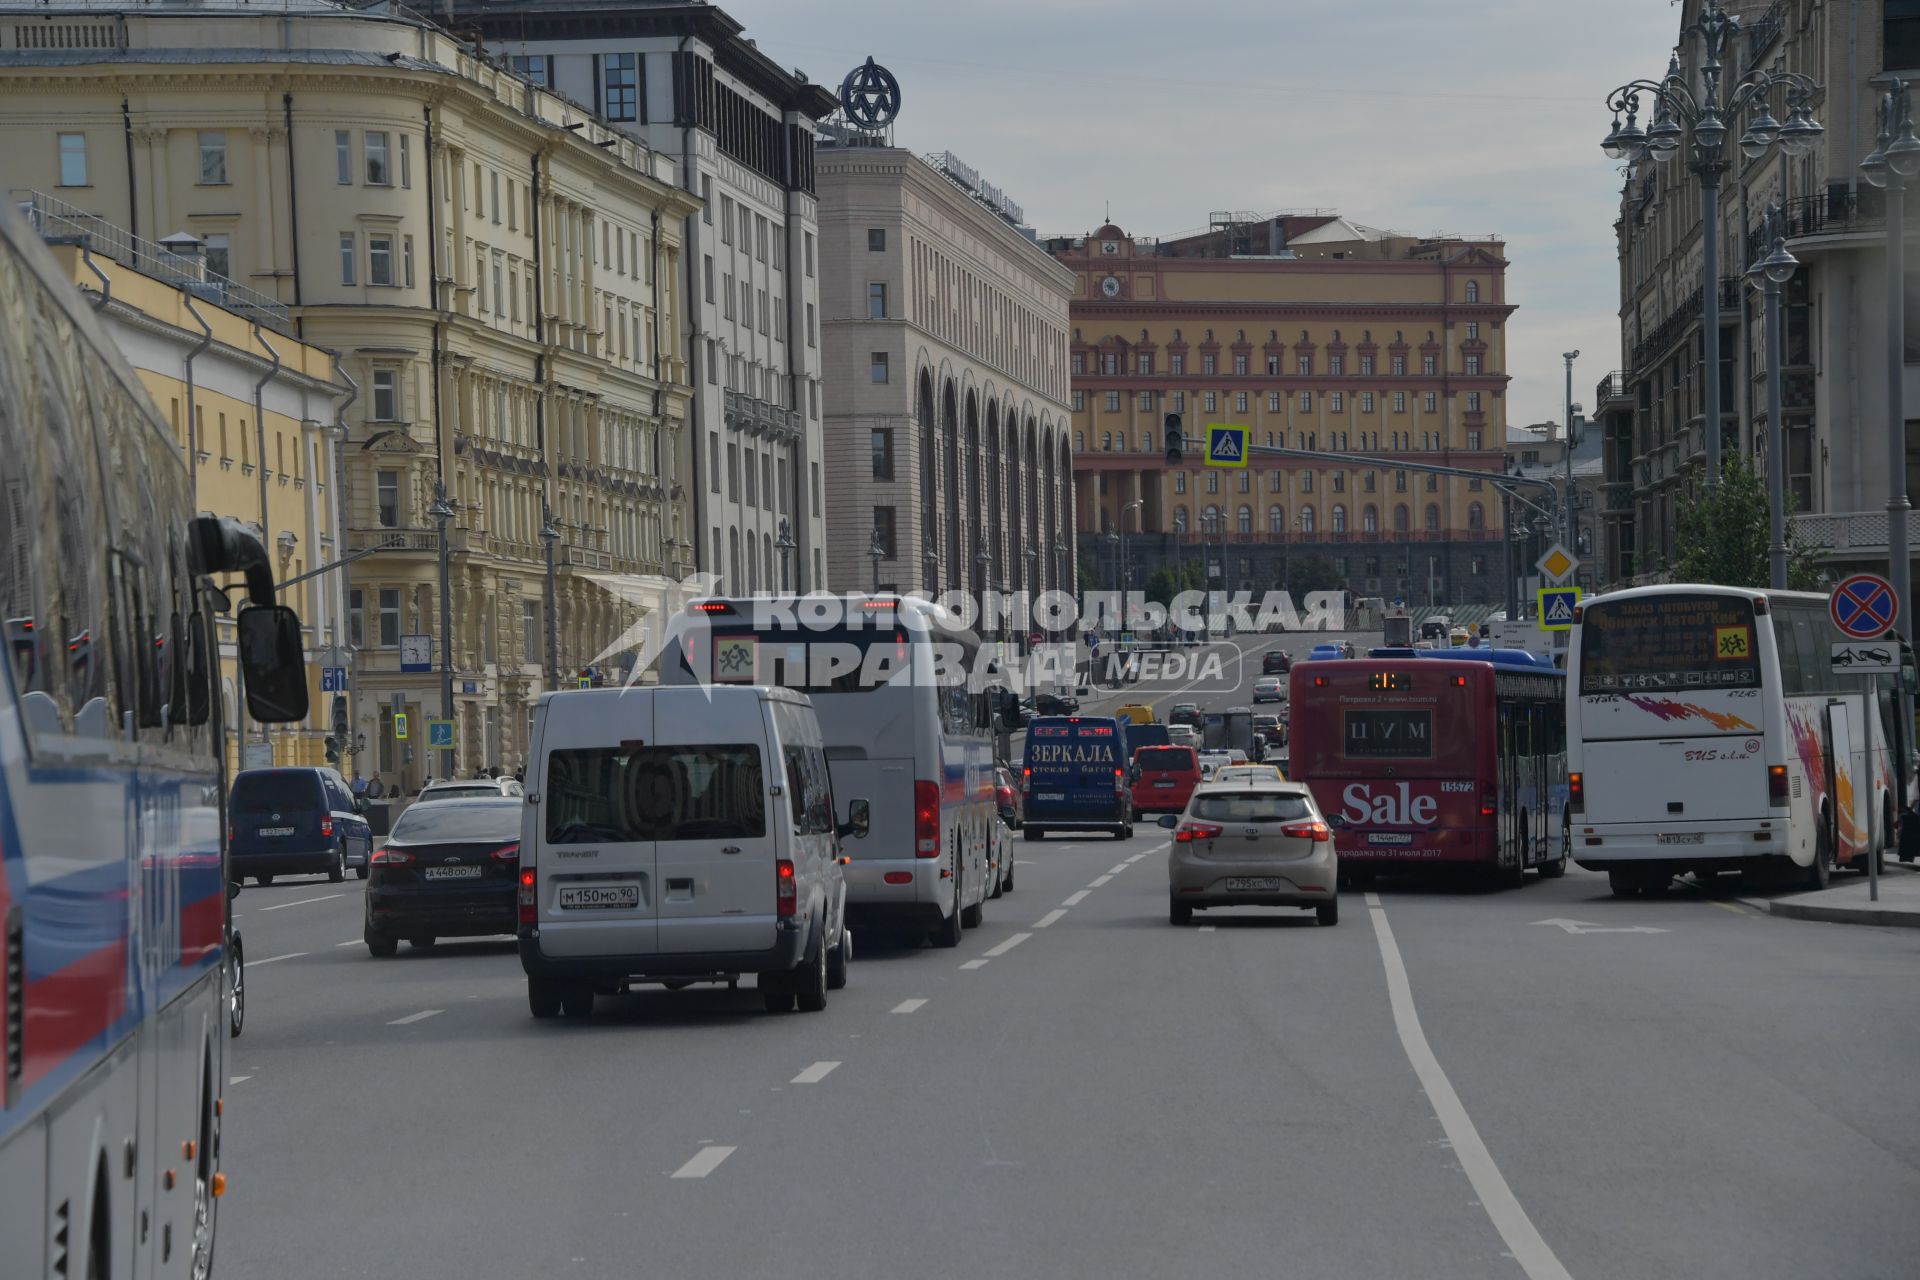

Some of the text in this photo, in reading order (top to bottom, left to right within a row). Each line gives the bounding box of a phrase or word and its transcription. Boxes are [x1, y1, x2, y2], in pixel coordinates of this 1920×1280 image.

[1622, 602, 1719, 614] ЗАКАЗ АВТОБУСОВ
[1728, 690, 1759, 698] ATLAS
[1747, 742, 1757, 750] 60
[1031, 744, 1115, 762] ЗЕРКАЛА
[1684, 749, 1718, 762] BUS
[1032, 764, 1113, 774] стекло багет
[1441, 781, 1474, 792] 15572
[1342, 782, 1438, 825] Sale
[1335, 849, 1374, 858] спродажа
[1388, 849, 1397, 857] 31
[1399, 849, 1421, 857] июля
[1422, 849, 1442, 857] 2017
[565, 888, 633, 903] М150МО 90
